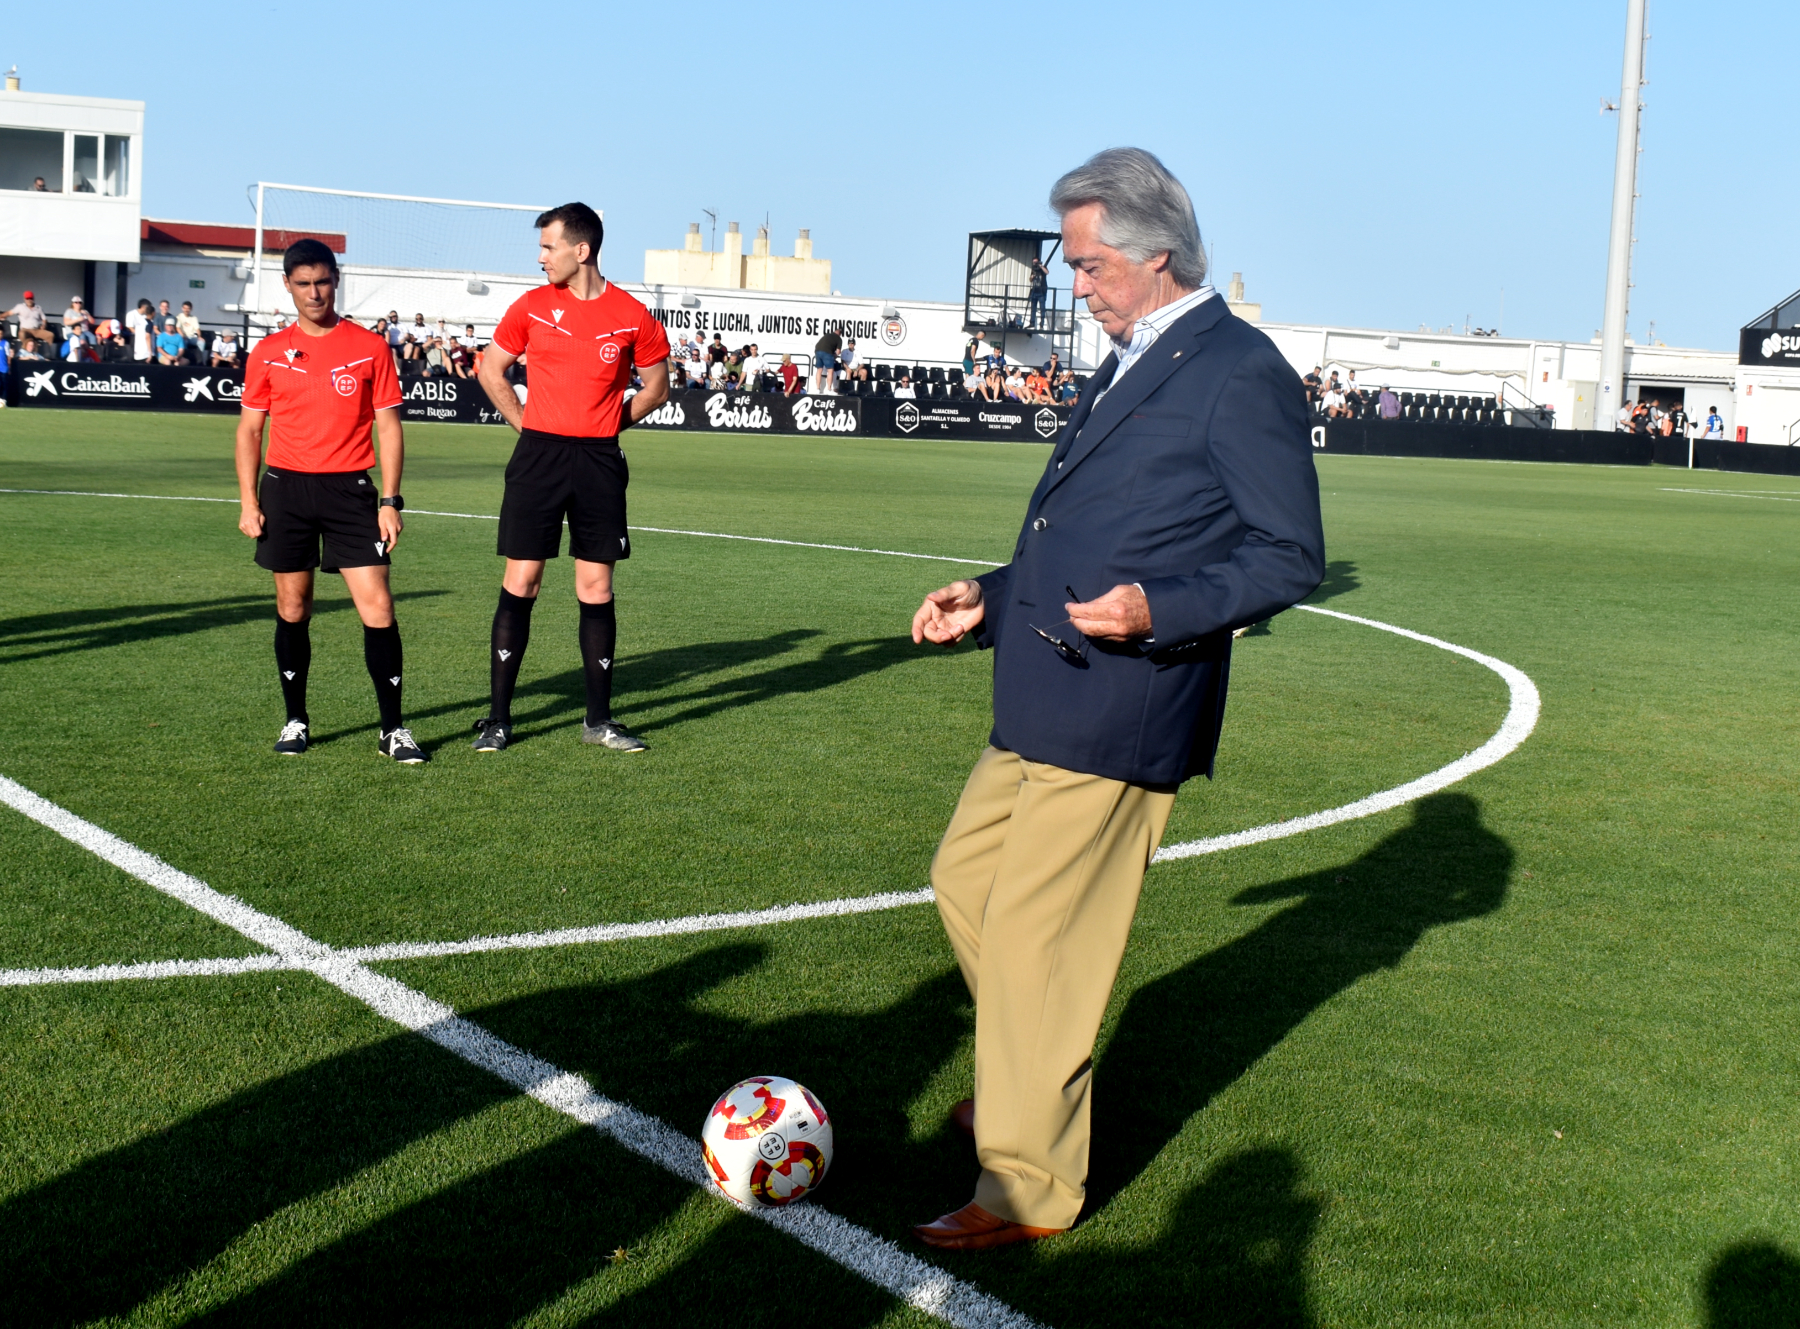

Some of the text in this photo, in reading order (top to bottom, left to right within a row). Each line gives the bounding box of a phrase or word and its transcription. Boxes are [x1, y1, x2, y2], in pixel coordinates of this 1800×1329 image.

[695, 311, 709, 330] SE
[713, 312, 753, 335] LUCHA,
[758, 315, 802, 335] JUNTOS
[806, 318, 819, 336] SE
[823, 319, 878, 339] CONSIGUE
[61, 372, 151, 394] CaixaBank
[813, 399, 836, 410] Café
[427, 406, 457, 419] Bugao
[979, 411, 1022, 425] Cruzcampo
